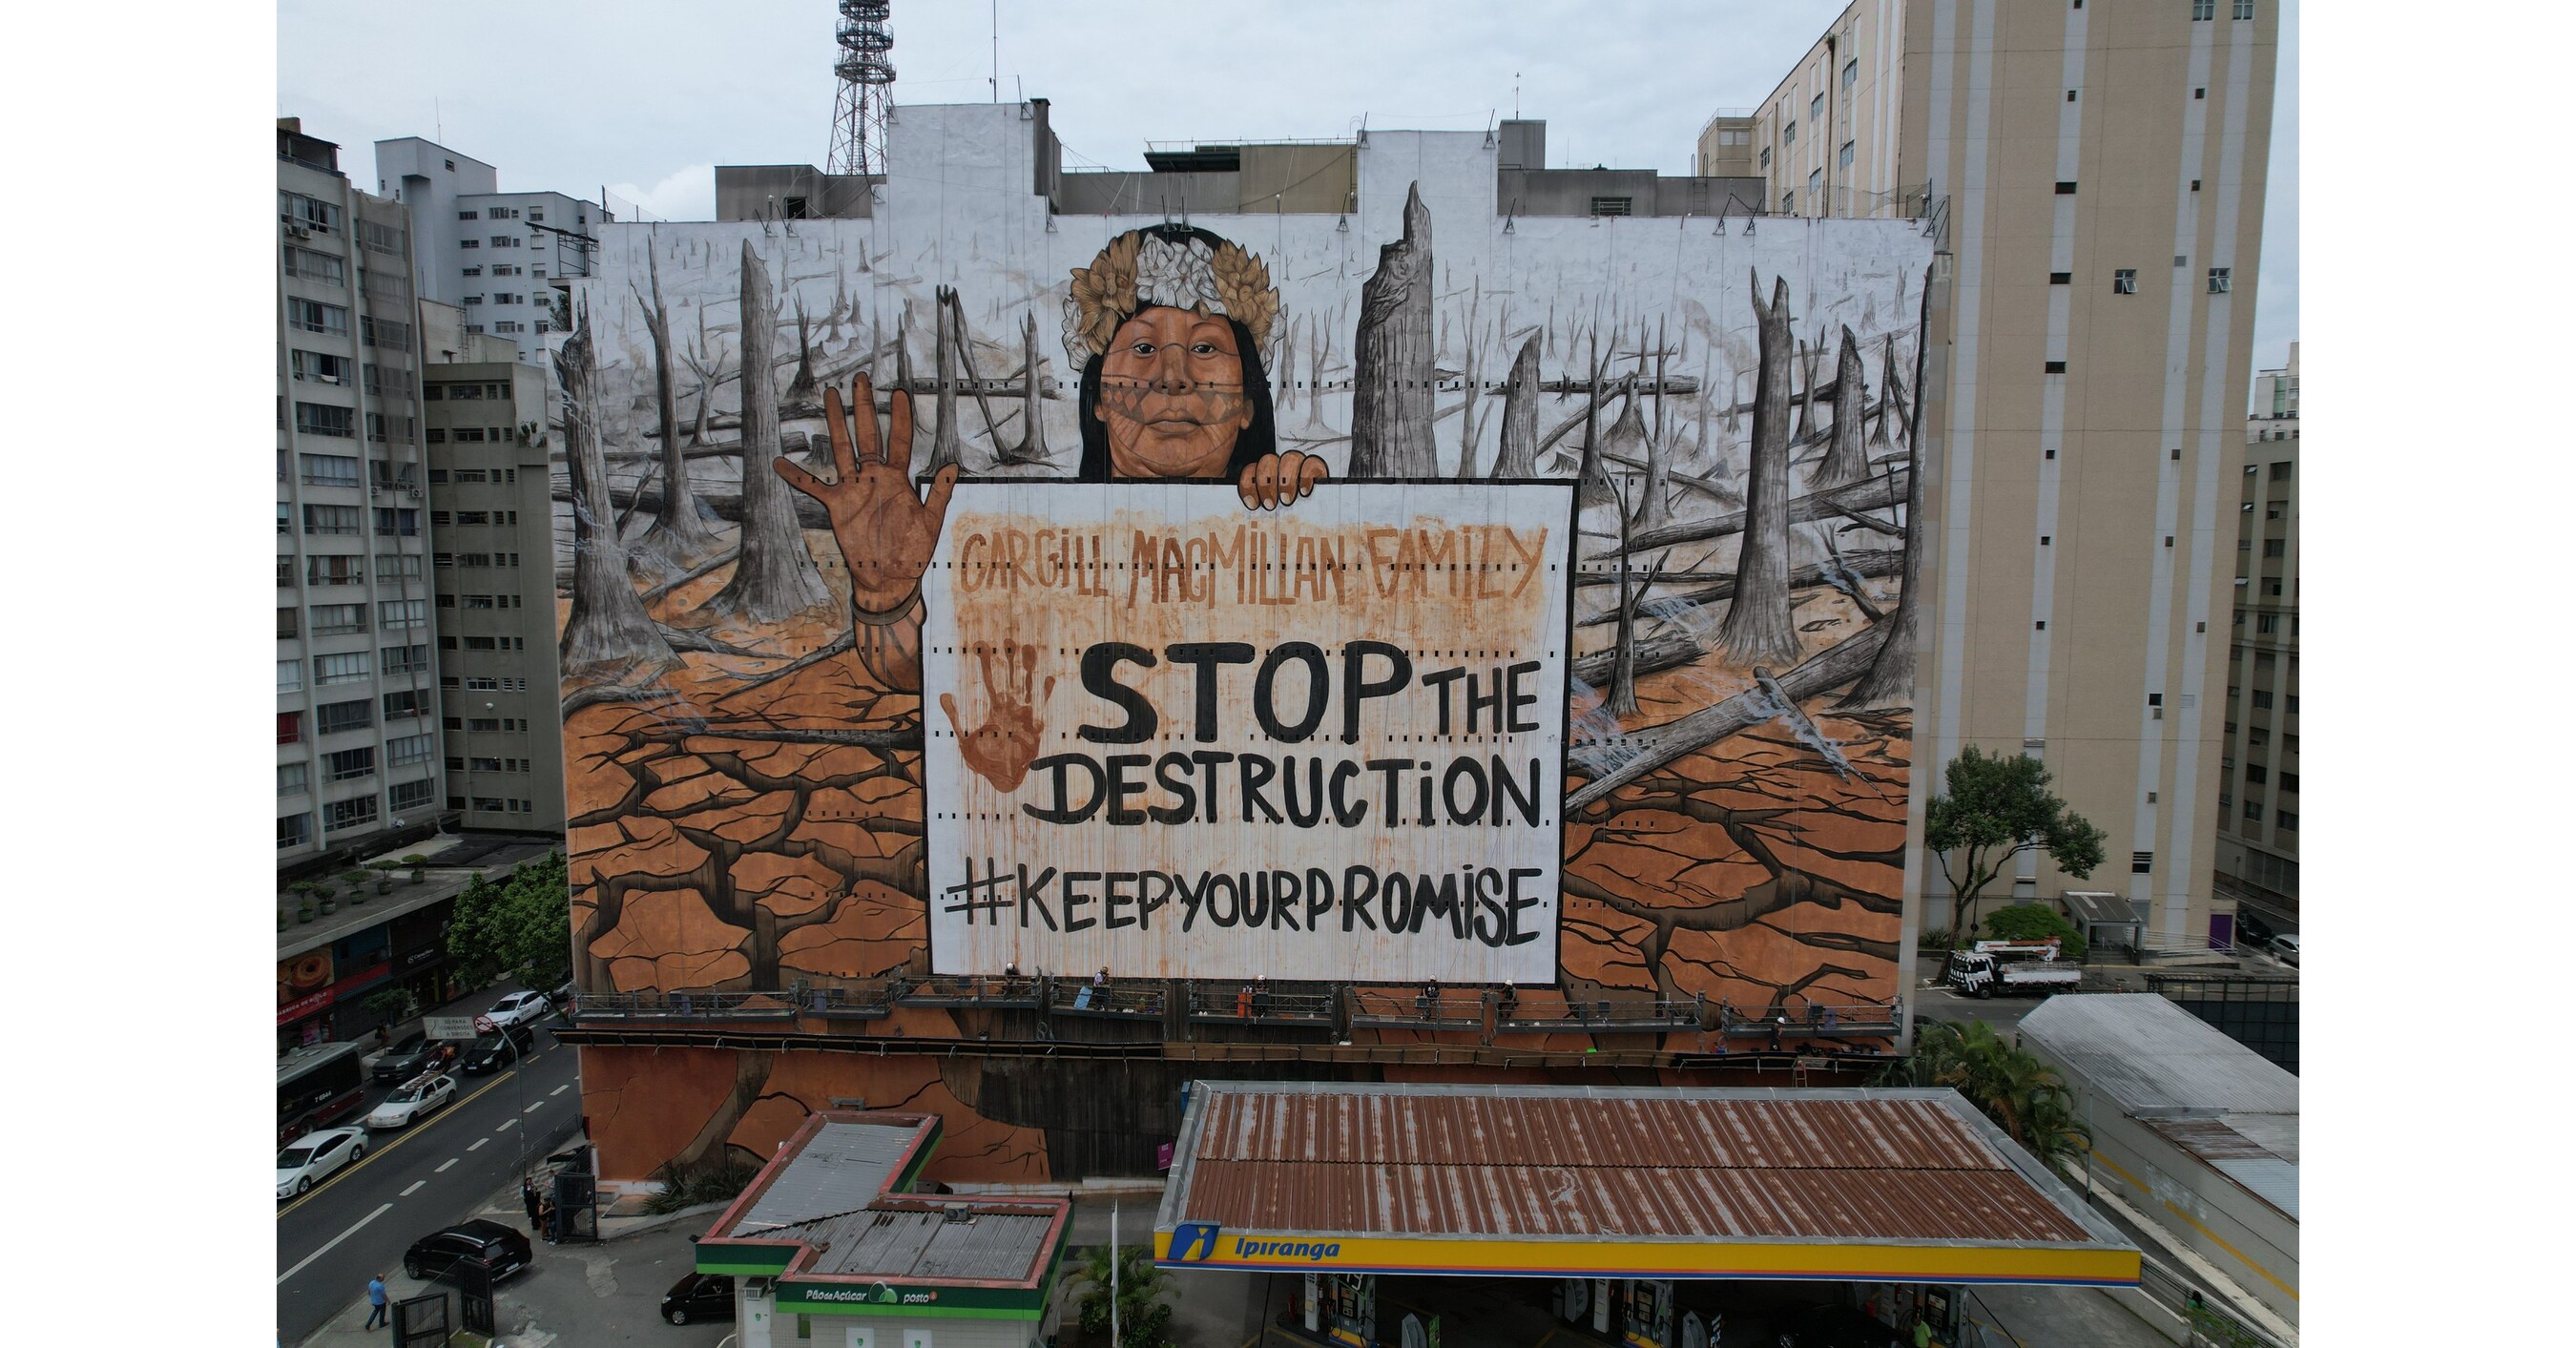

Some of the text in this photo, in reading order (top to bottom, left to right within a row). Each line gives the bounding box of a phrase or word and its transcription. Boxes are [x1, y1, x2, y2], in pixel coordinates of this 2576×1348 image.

[1078, 641, 1542, 745] STOP THE
[1236, 1238, 1340, 1261] Ipiranga
[903, 1293, 930, 1304] posto
